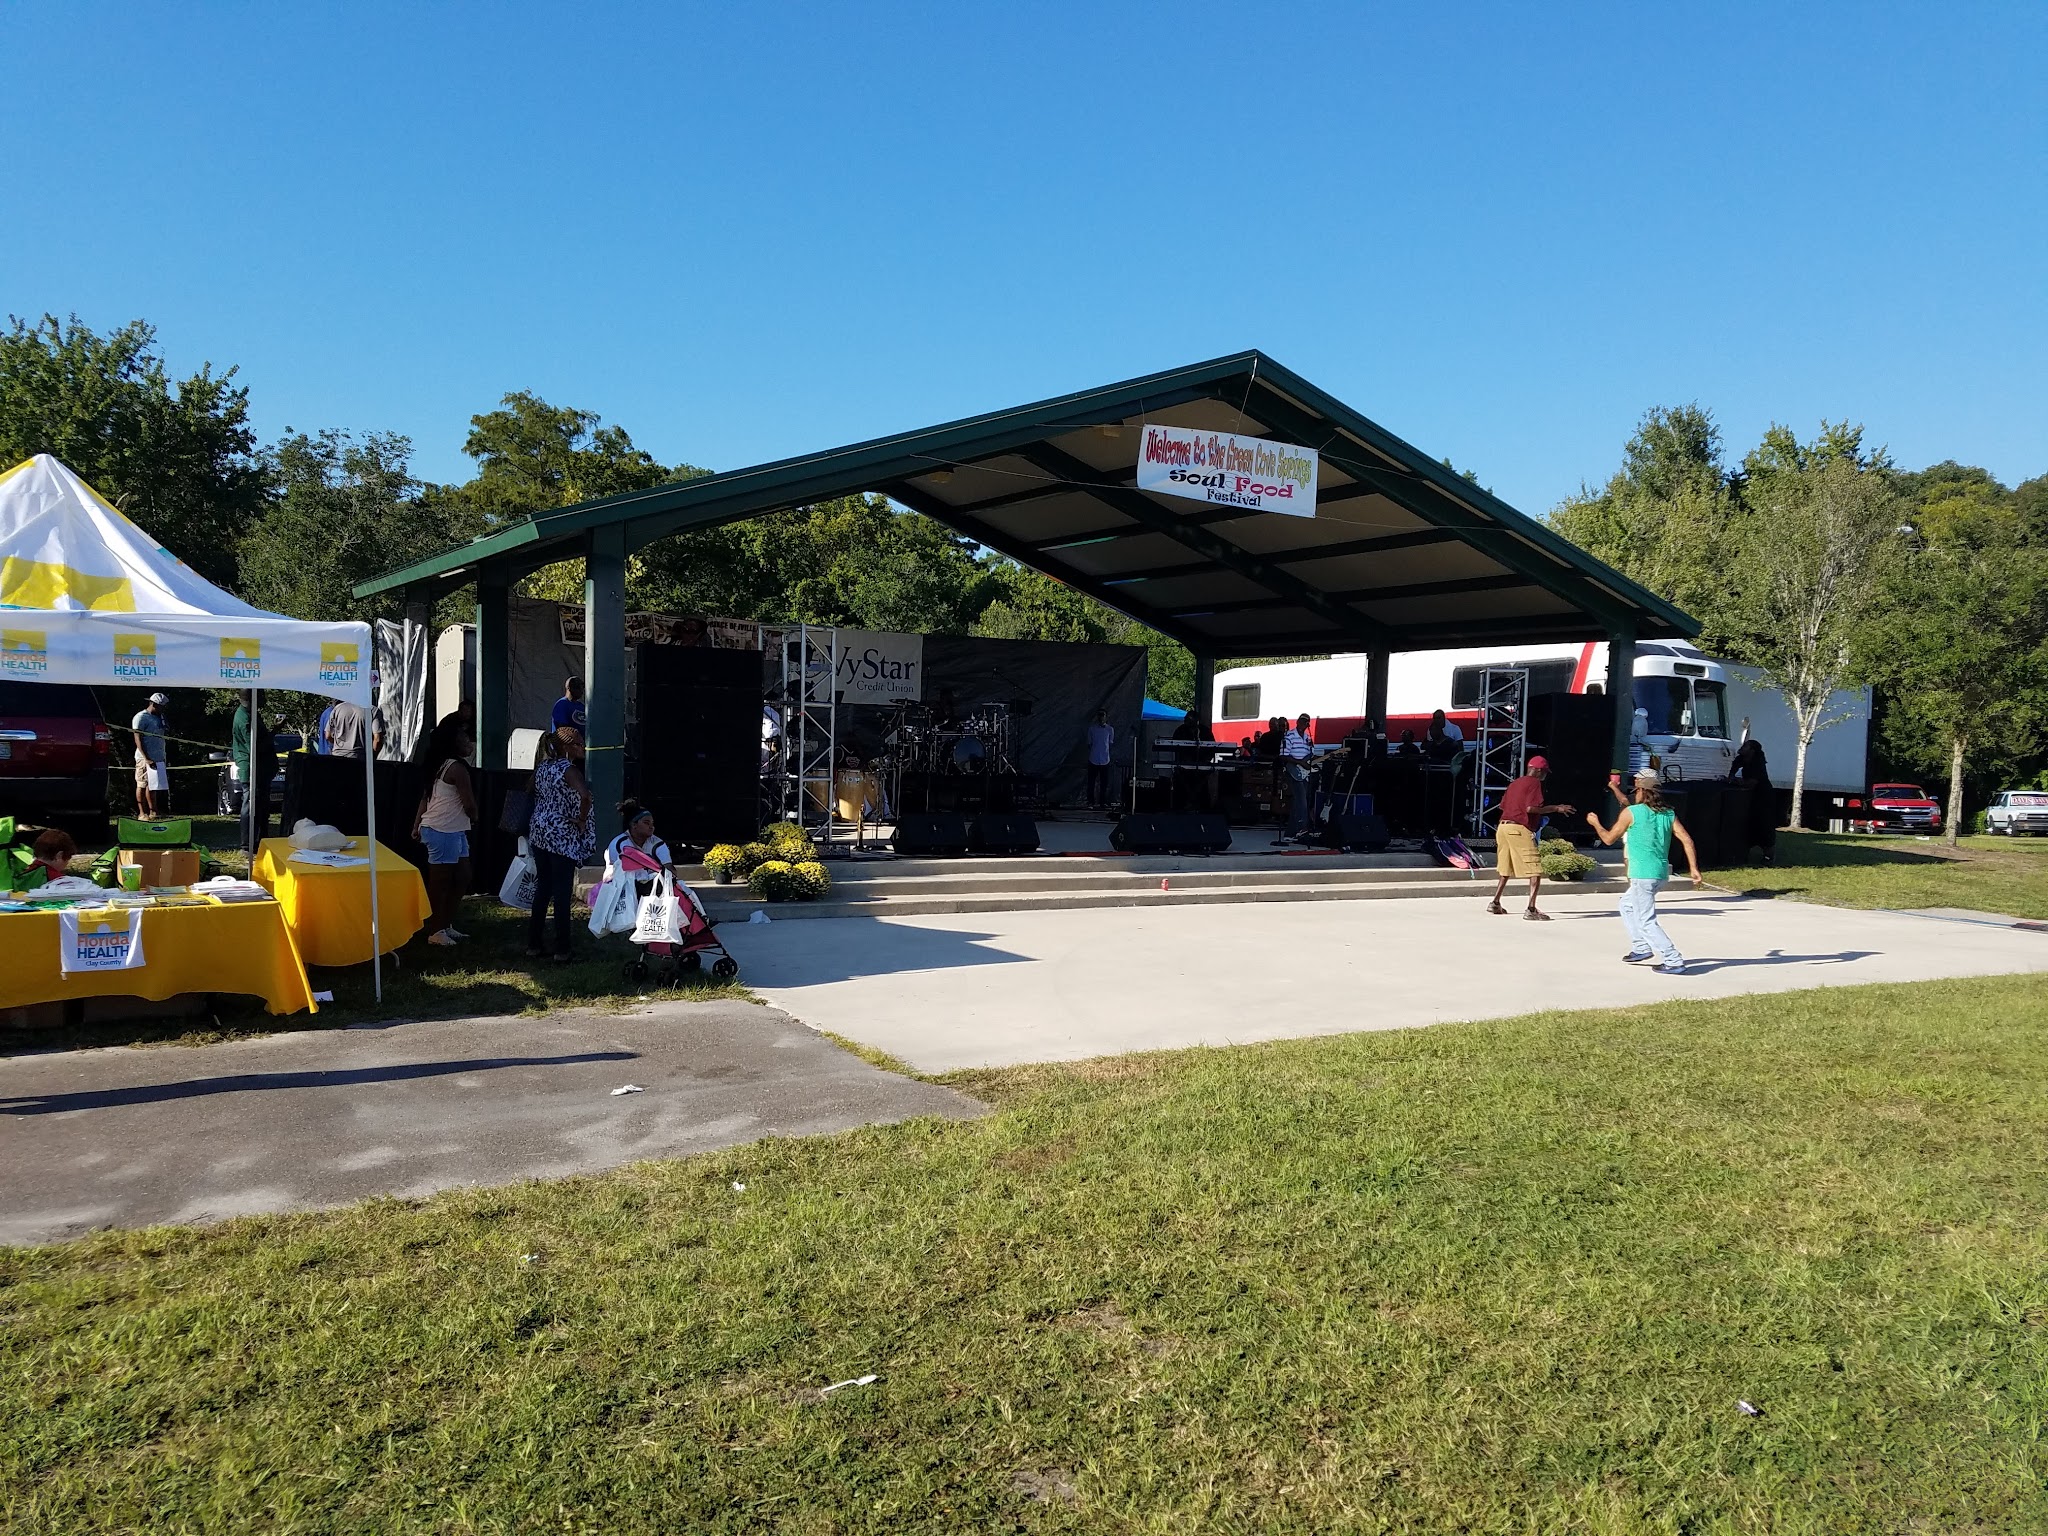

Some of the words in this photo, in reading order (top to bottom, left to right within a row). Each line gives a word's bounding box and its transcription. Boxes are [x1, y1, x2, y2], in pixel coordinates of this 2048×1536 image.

[1146, 429, 1191, 467] Welcome
[1193, 435, 1206, 467] to
[1208, 435, 1225, 470] the
[1226, 438, 1254, 476] Green
[1255, 443, 1276, 478] Cove
[1277, 447, 1312, 489] Springs
[1169, 469, 1225, 489] Soul
[1235, 476, 1294, 498] Food
[1207, 488, 1261, 507] Festival
[1, 660, 47, 671] HEALTH
[113, 655, 156, 666] Florida
[220, 658, 260, 669] Florida
[825, 645, 916, 685] VyStar
[113, 666, 157, 676] HEALTH
[320, 663, 358, 672] Florida
[220, 669, 261, 678] HEALTH
[319, 671, 358, 681] HEALTH
[856, 680, 885, 692] Credit
[886, 681, 914, 693] Union
[77, 933, 130, 947] Florida
[77, 945, 130, 959] HEALTH
[100, 959, 122, 967] County
